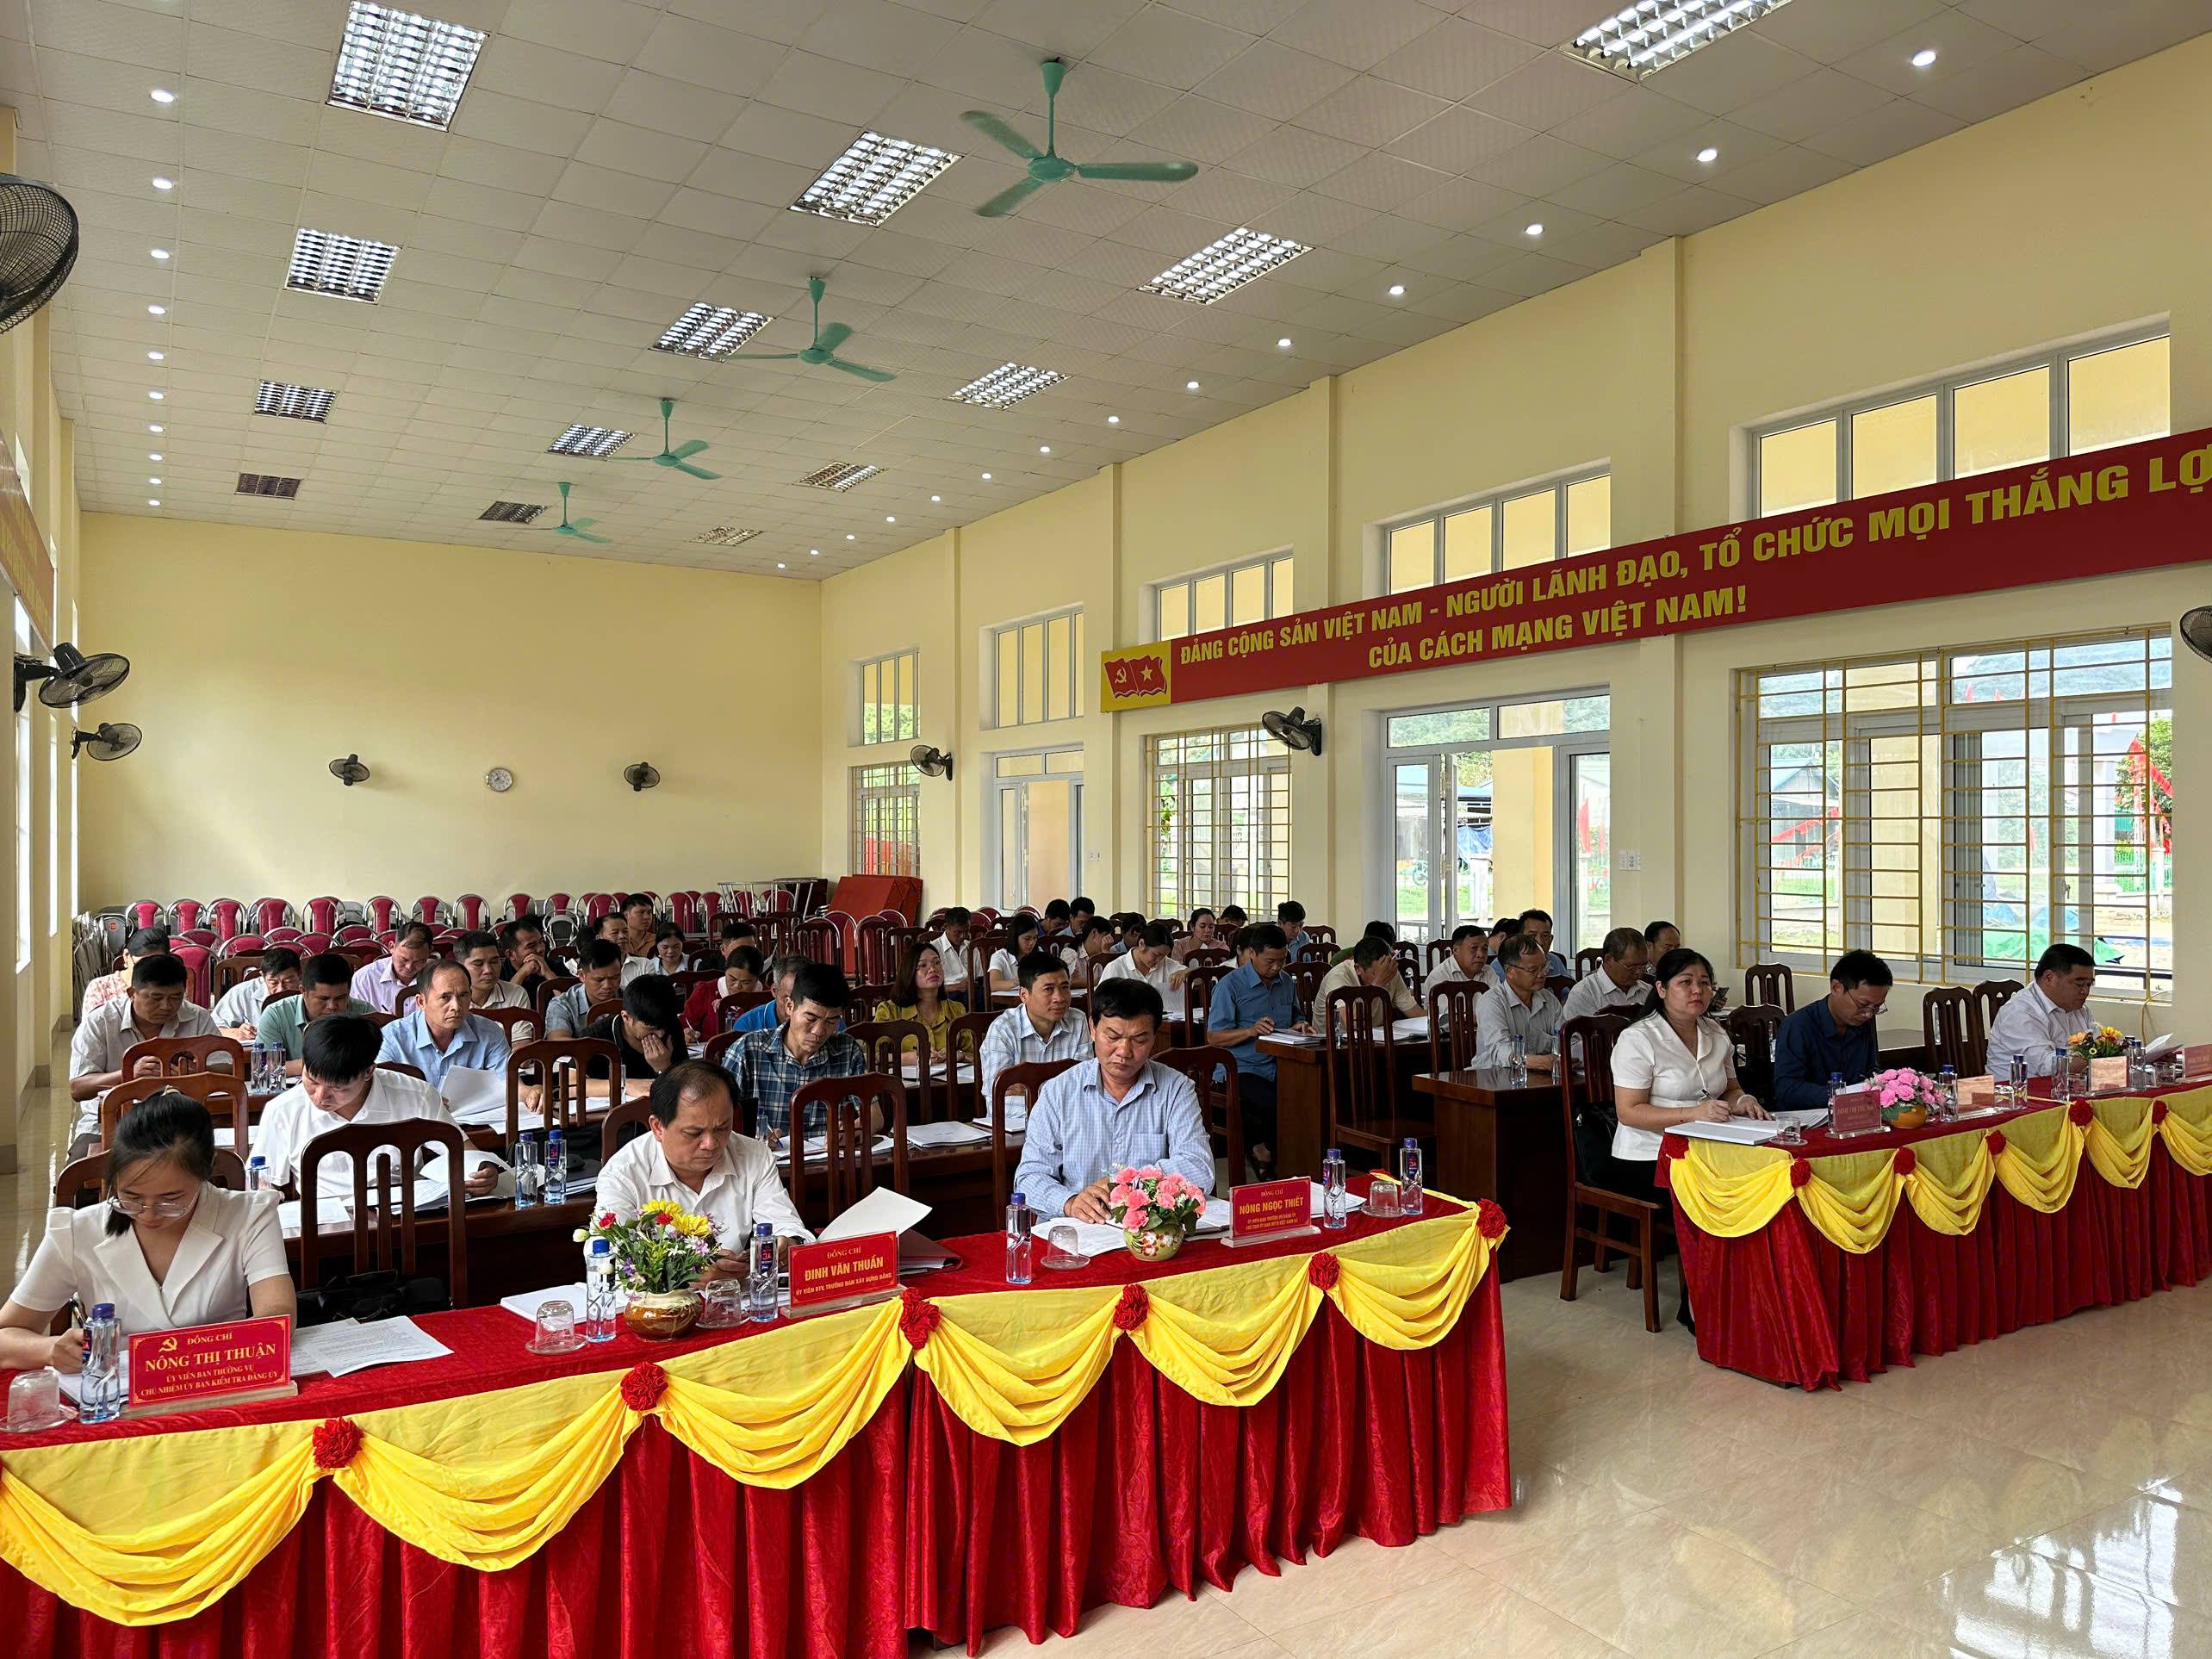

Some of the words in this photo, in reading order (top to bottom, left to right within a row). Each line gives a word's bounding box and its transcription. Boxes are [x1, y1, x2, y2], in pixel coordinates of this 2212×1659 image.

[1181, 637, 1223, 665] ĐẢNG
[1227, 630, 1274, 657] CỘNG
[1280, 618, 1318, 647] SẢN
[1323, 612, 1365, 641] VIỆT
[1371, 602, 1422, 631] NAM
[1445, 578, 1524, 618] NGƯỜI
[1532, 565, 1606, 602] LÃNH
[1616, 550, 1688, 587] ĐẠO,
[1699, 526, 1743, 571] TỔ
[1753, 516, 1854, 562] CHỨC
[1868, 498, 1949, 541] MỌI
[1966, 464, 2129, 525] THẮNG
[1369, 637, 1413, 668] CỦA
[1419, 630, 1483, 661] CÁCH
[1491, 614, 1573, 650] MẠNG
[1581, 600, 1646, 637] VIỆT
[1656, 585, 1746, 625] NAM!
[1240, 1203, 1260, 1215] NÔNG
[1263, 1200, 1283, 1211] NGỌC
[805, 1266, 828, 1281] ĐINH
[830, 1262, 850, 1276] VĂN
[146, 1355, 189, 1371] NÔNG
[194, 1351, 221, 1365] THỊ
[224, 1342, 276, 1359] THUẬN
